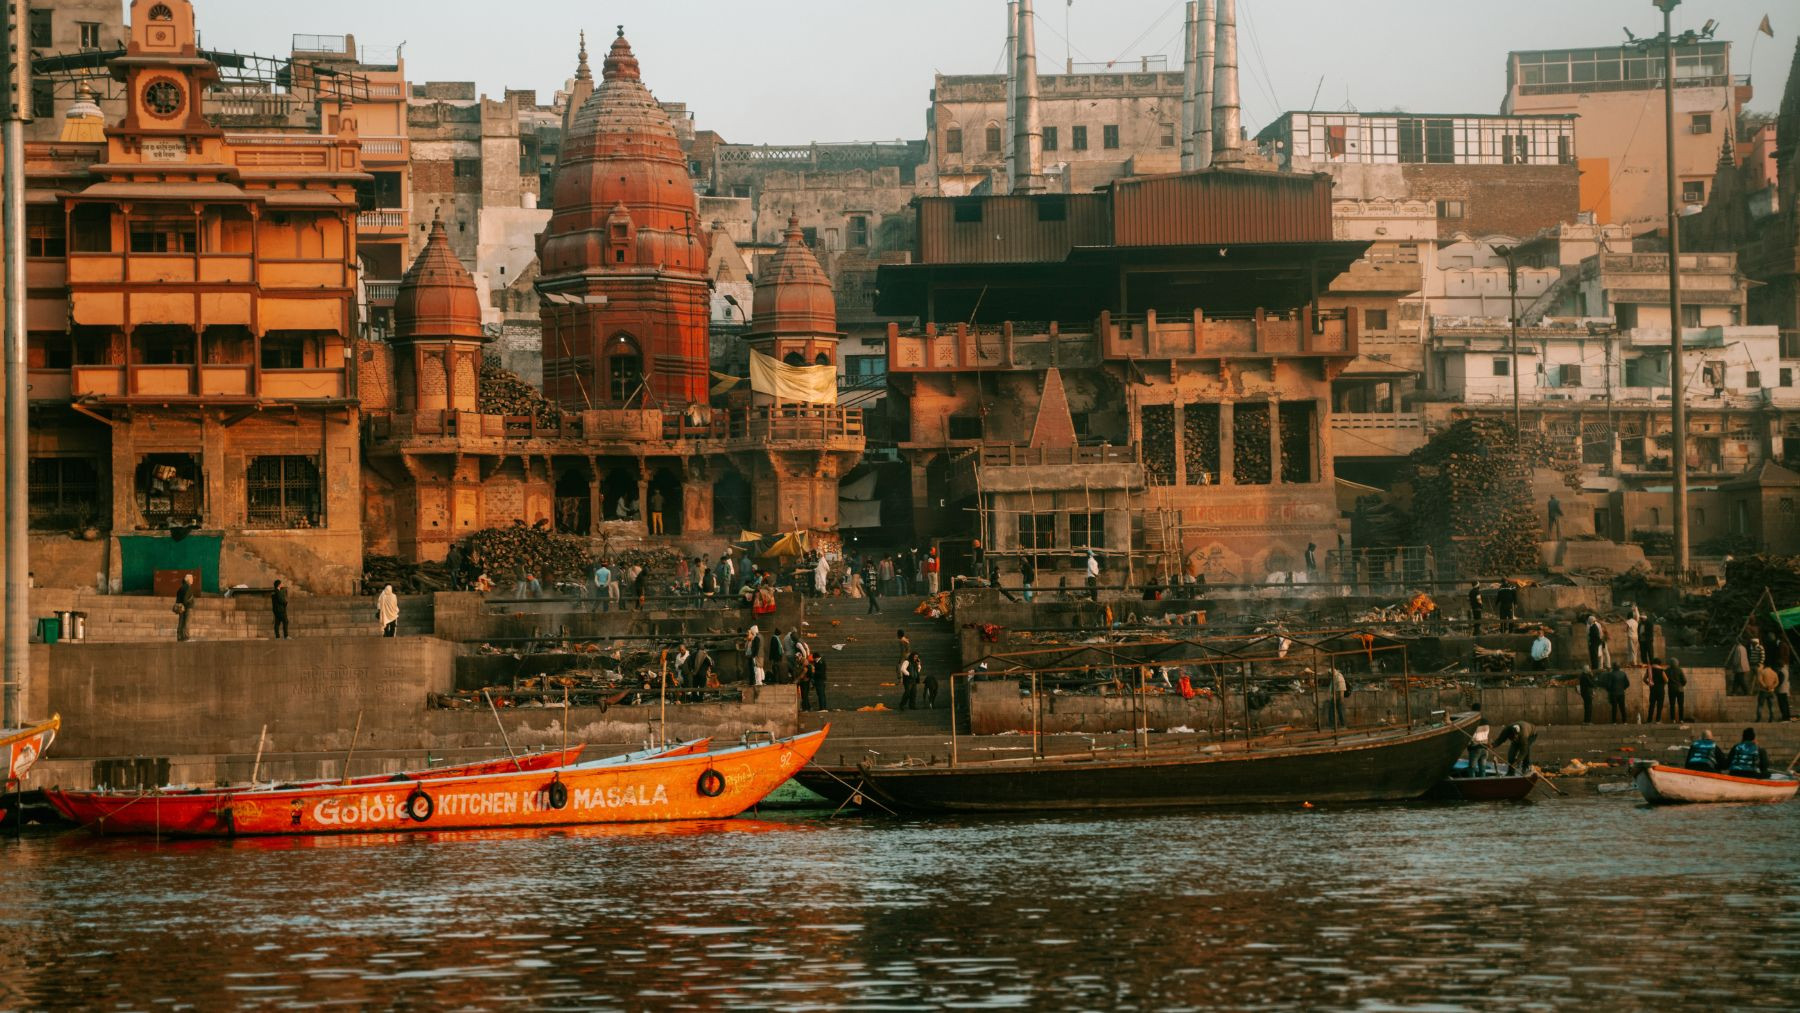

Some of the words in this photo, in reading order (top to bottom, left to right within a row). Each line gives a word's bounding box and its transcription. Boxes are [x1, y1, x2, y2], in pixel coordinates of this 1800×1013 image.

[780, 751, 792, 768] 92
[438, 792, 517, 816] KITCHEN
[522, 790, 567, 813] KIN
[573, 784, 669, 809] MASALA
